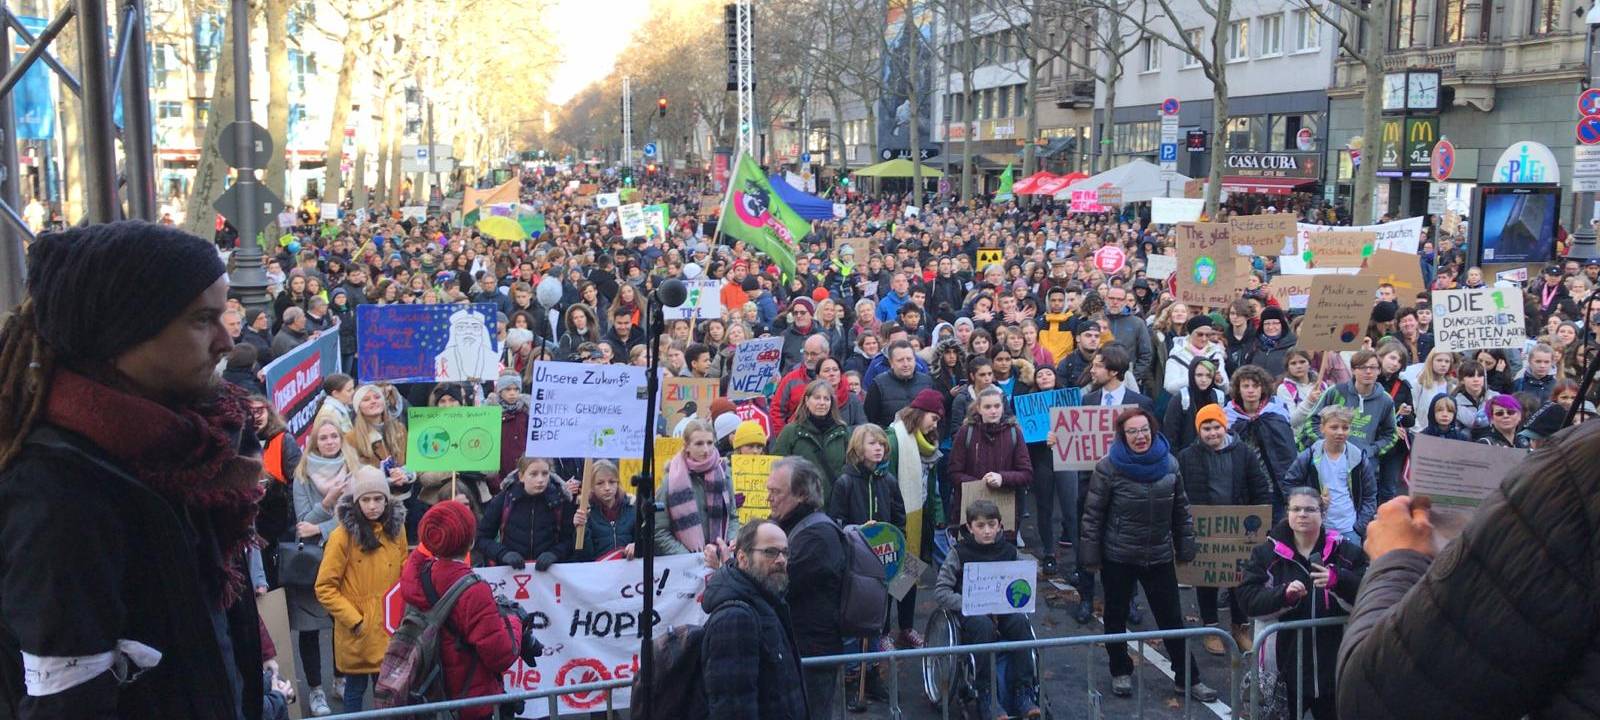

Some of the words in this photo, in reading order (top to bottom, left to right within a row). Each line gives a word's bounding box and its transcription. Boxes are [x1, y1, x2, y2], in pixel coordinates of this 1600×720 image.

[1229, 155, 1259, 168] CASA
[1260, 156, 1297, 169] CUBA
[1447, 292, 1483, 313] DIE
[1443, 313, 1517, 329] DINOSAURIER
[1439, 326, 1503, 342] DACHTEN
[535, 366, 578, 385] Unsere
[531, 430, 560, 441] ERDE
